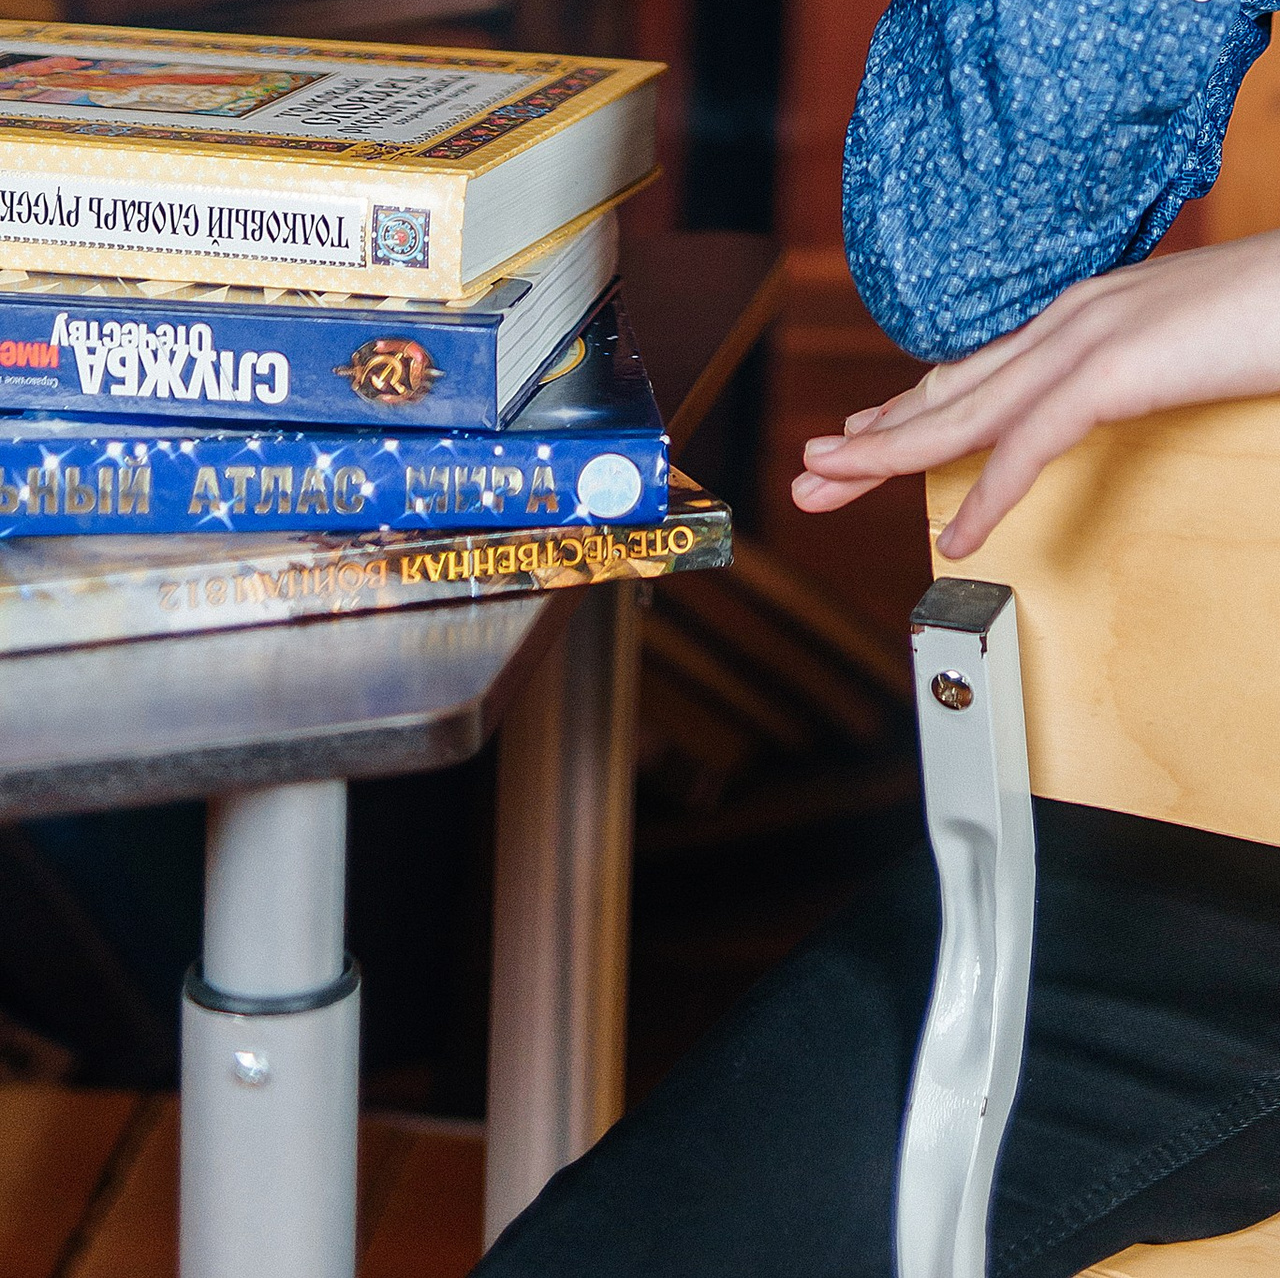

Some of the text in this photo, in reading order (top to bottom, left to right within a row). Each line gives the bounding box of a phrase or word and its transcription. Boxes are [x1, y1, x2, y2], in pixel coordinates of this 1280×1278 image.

[301, 75, 428, 126] СЛОВАРЬ
[0, 186, 350, 249] ТОЛКОВЫЙ СЛОВАРЬ РУССК
[50, 312, 213, 359] Отечеству
[73, 343, 290, 405] СЛУЖБА
[187, 465, 366, 516] АТЛАС
[405, 465, 560, 516] МИРА
[400, 525, 695, 585] ОТЕЧЕСТВЕННАЯ
[157, 573, 246, 612] 1812
